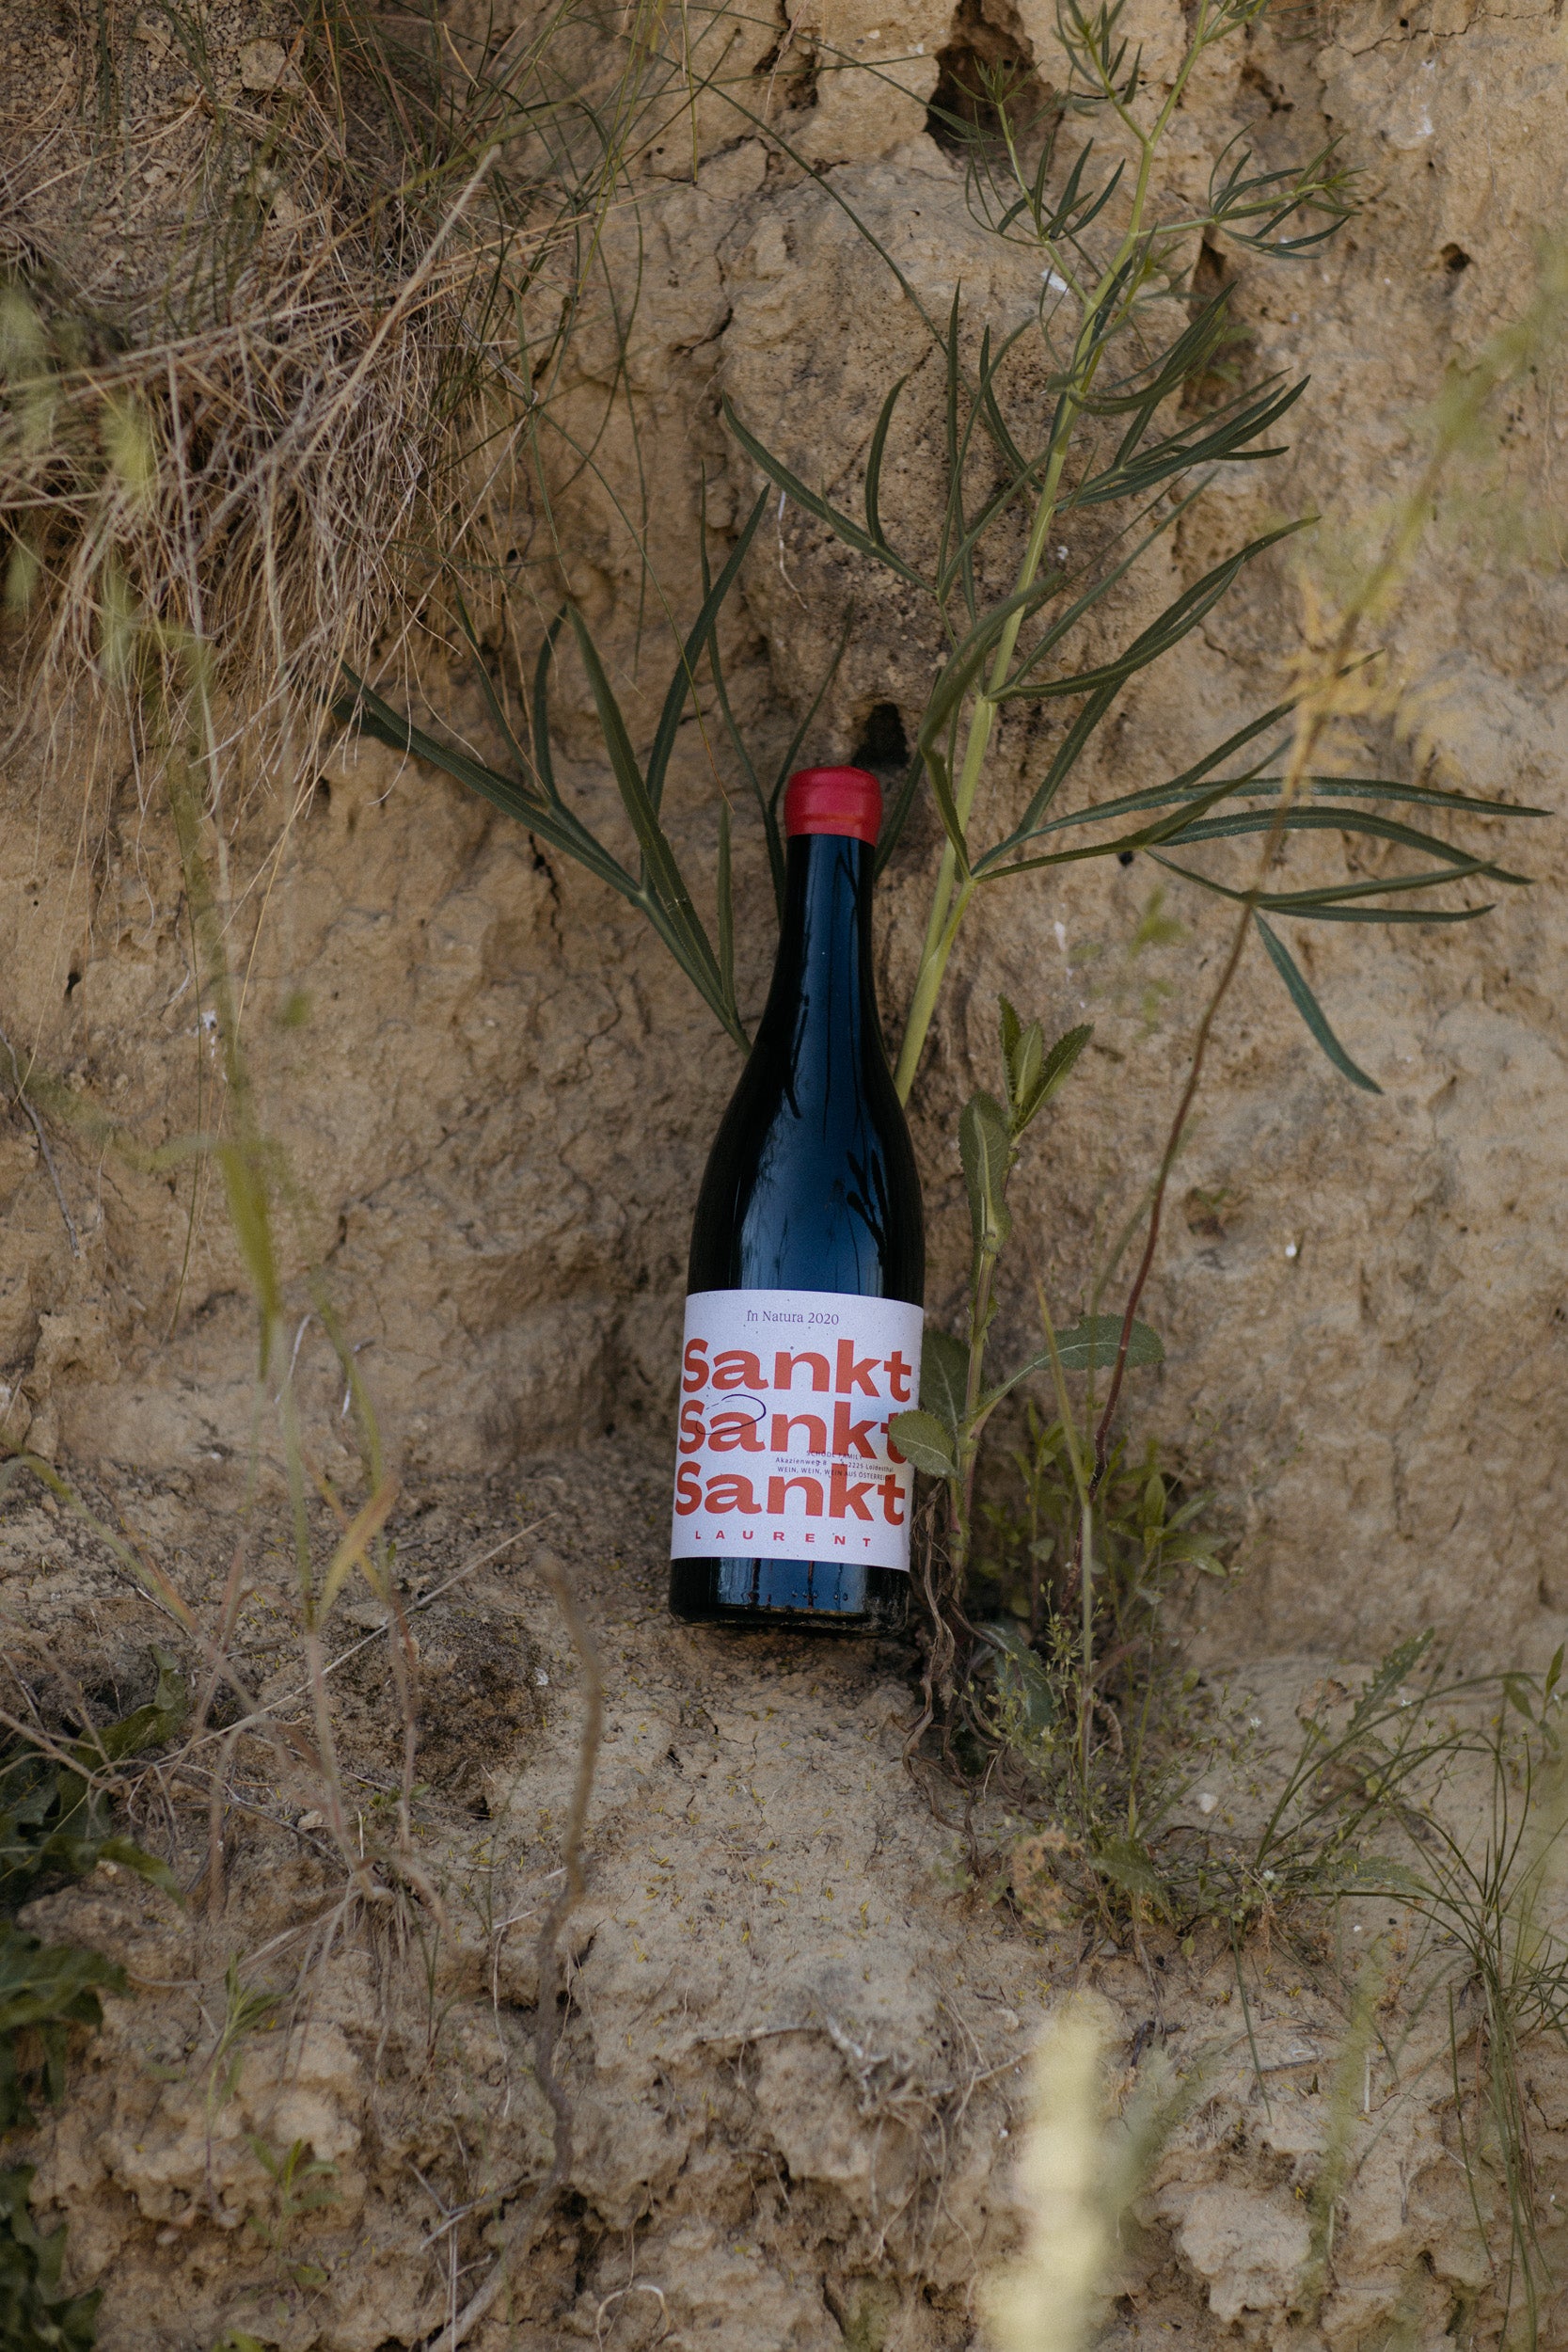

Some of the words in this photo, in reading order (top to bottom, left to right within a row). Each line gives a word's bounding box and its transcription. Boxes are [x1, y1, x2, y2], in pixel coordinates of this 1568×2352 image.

[762, 1311, 803, 1323] Natura
[808, 1312, 839, 1325] 2020
[682, 1338, 912, 1403] Sankt
[775, 1457, 820, 1466] Akazienweg
[778, 1466, 798, 1474] WEIN,
[675, 1460, 906, 1525] Sankt
[695, 1530, 872, 1548] LAURENT
